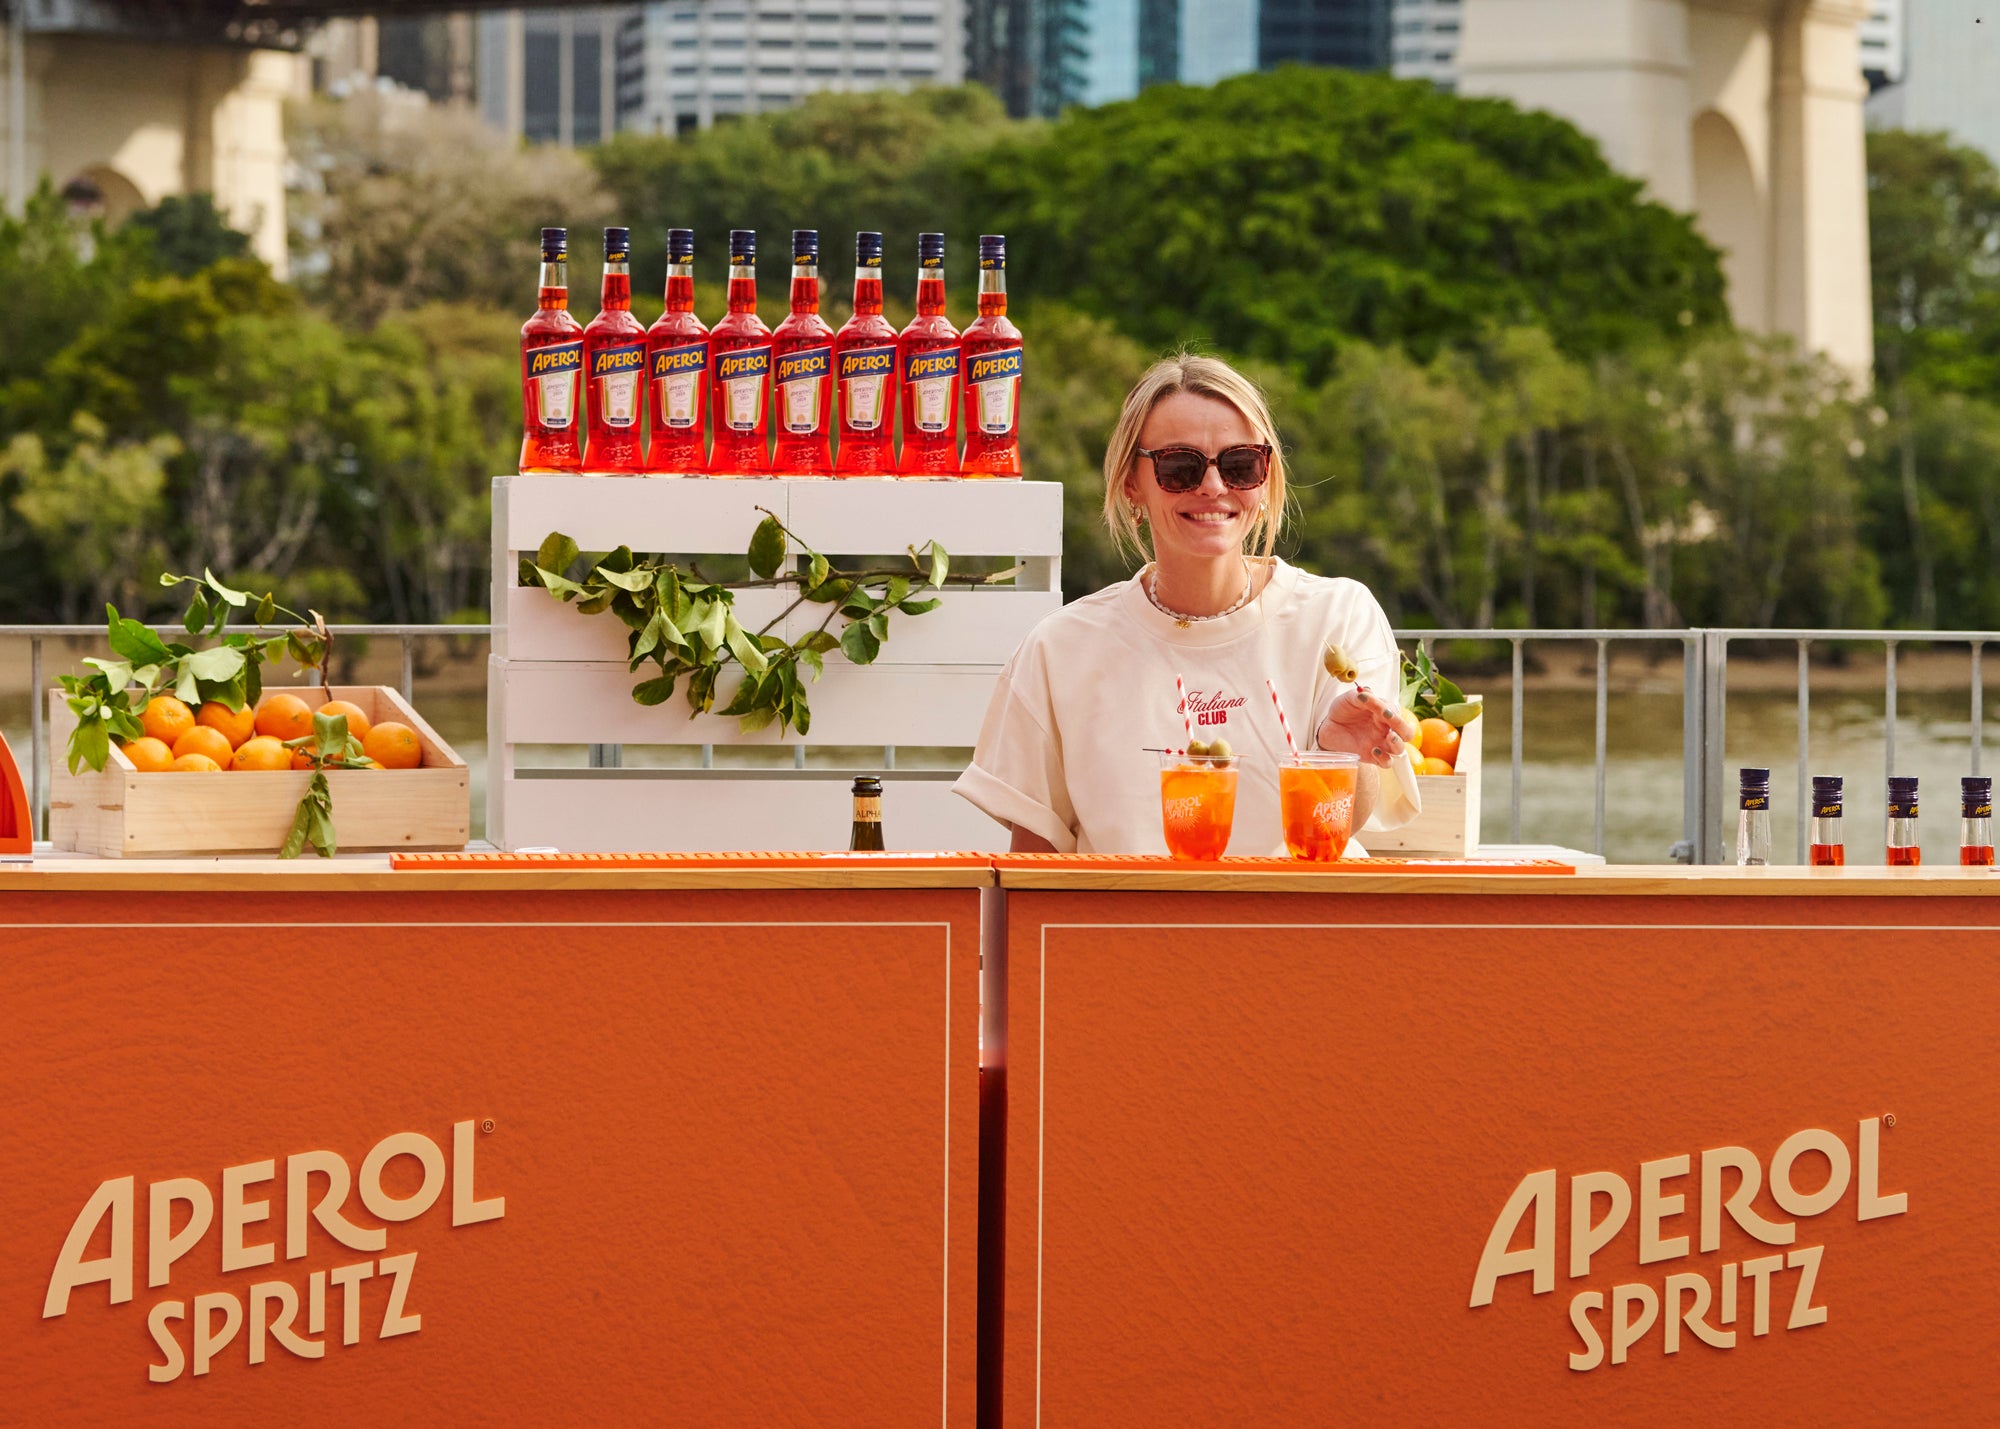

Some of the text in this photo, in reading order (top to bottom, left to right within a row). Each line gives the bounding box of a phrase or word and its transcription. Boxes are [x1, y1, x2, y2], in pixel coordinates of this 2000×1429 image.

[532, 349, 580, 373] APEROL
[596, 350, 643, 373] APEROL
[655, 351, 704, 373] APEROL
[719, 356, 768, 377] APEROL
[778, 356, 826, 379] APEROL
[842, 354, 891, 374] APEROL
[909, 357, 956, 377] APEROL
[972, 358, 1019, 379] APEROL
[1177, 690, 1247, 714] Italiana
[1198, 710, 1227, 726] CLUB
[1165, 795, 1202, 813] APEROL
[1169, 807, 1194, 820] SPRITZ
[1313, 796, 1351, 817] APEROL
[1320, 809, 1347, 823] SPRITZ
[147, 1252, 421, 1383] SPRITZ
[1569, 1245, 1827, 1371] SPRITZ
